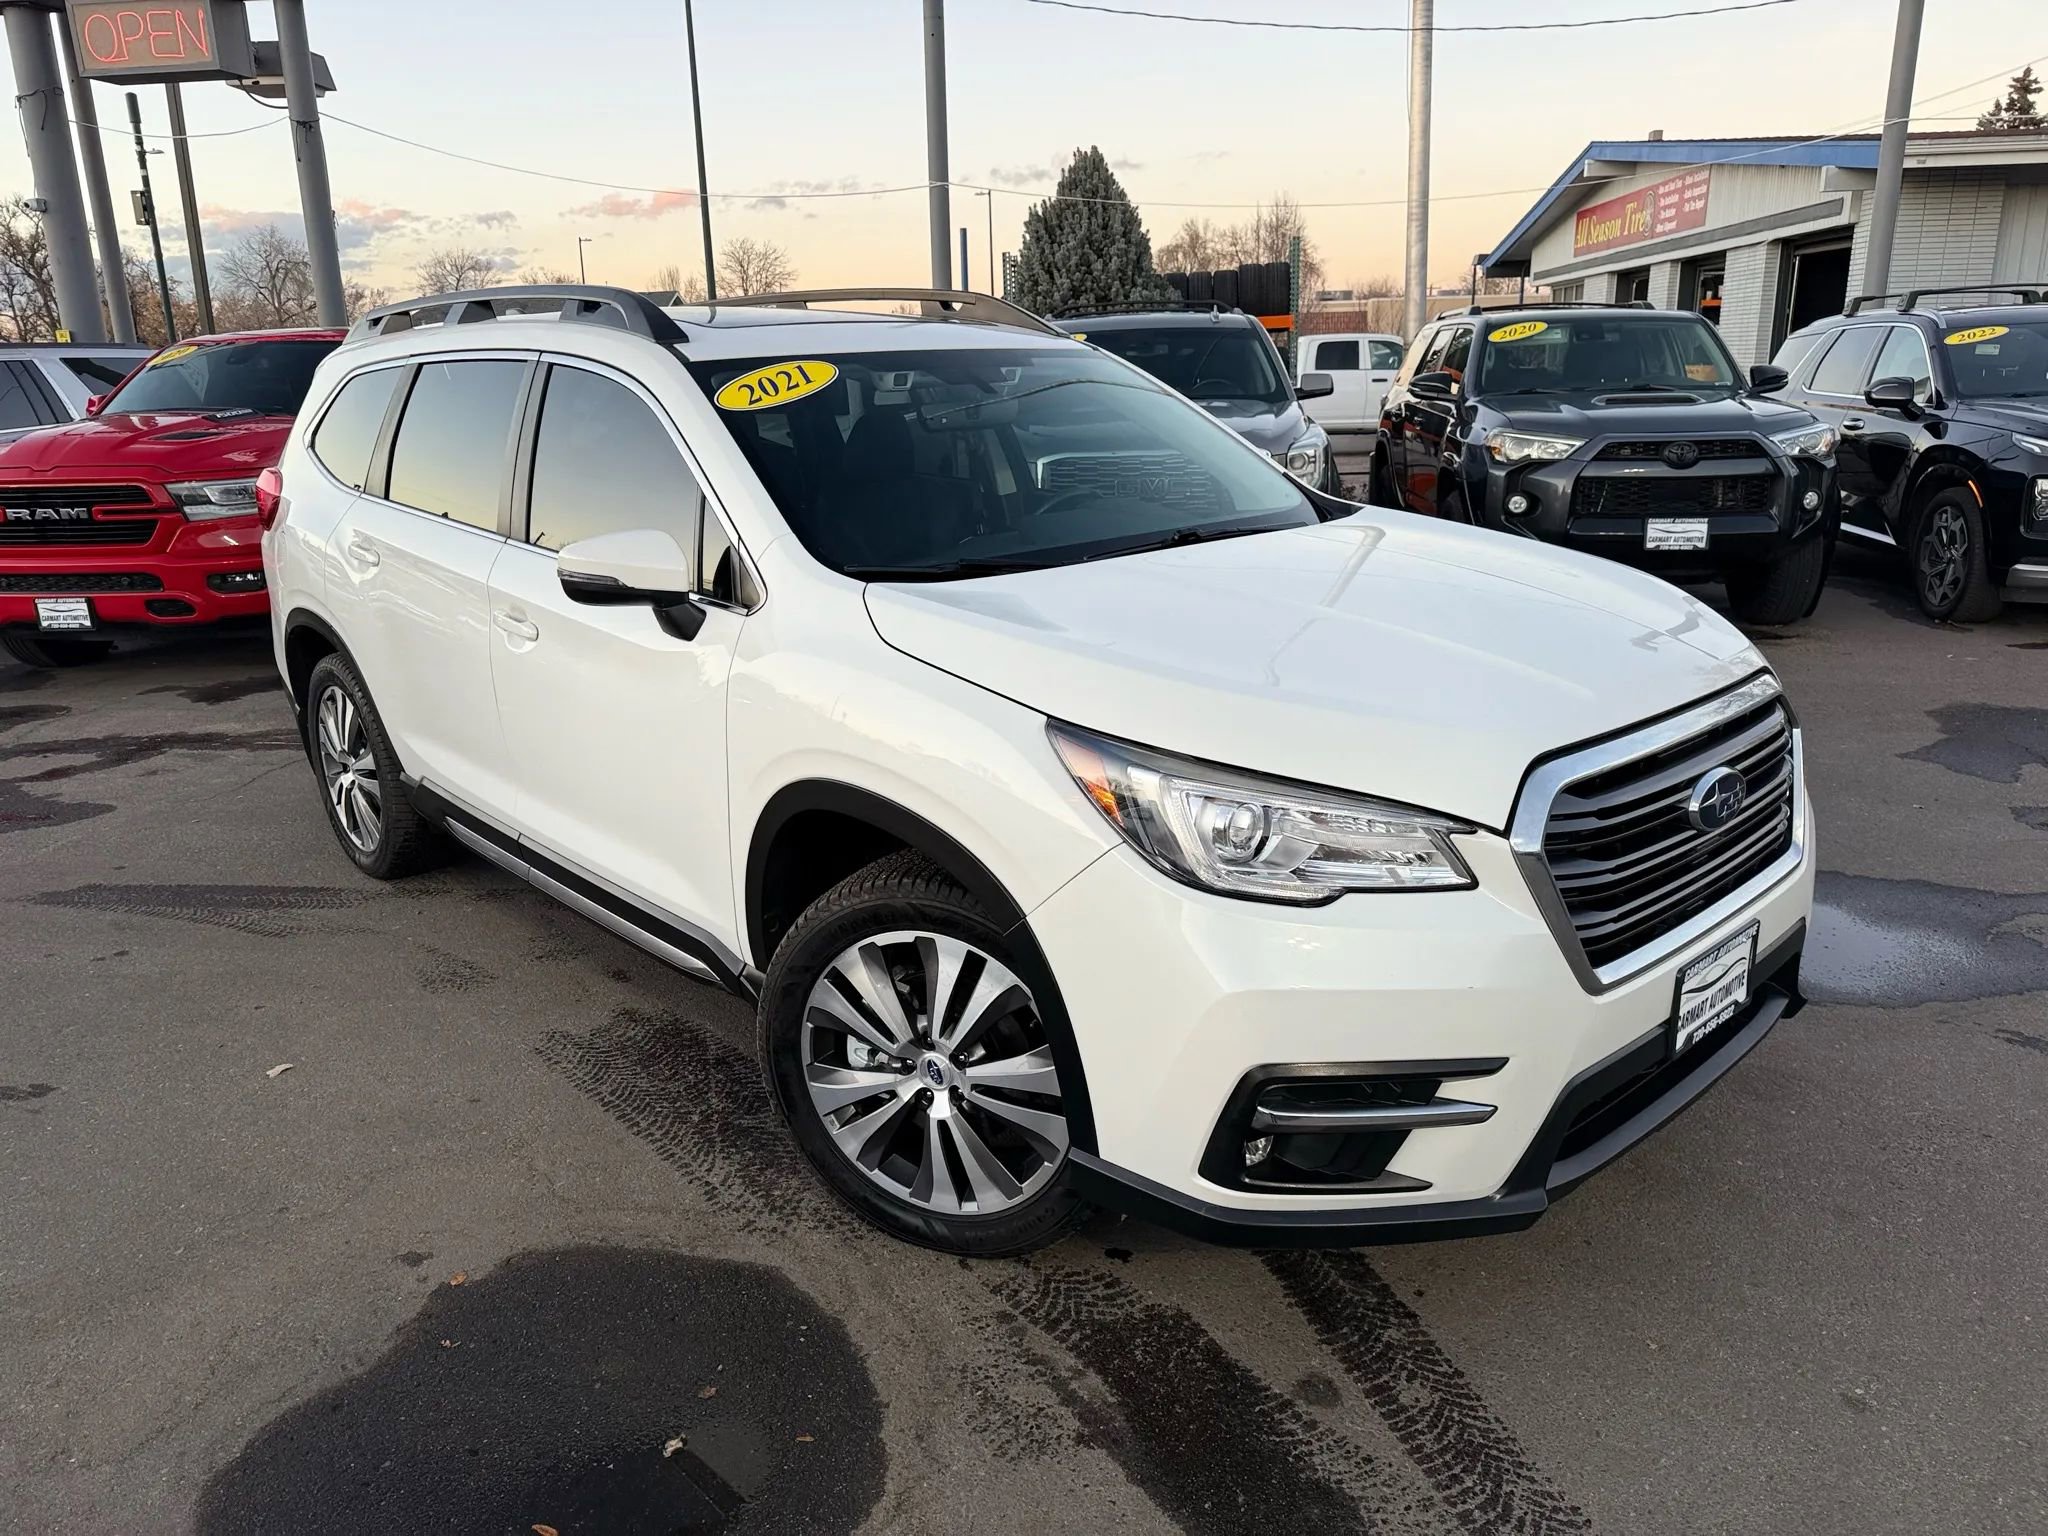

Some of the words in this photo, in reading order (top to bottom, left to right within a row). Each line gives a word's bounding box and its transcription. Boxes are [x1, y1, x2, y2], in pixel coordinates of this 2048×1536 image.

[85, 9, 208, 62] OPEN
[1574, 217, 1589, 248] All
[1588, 215, 1622, 245] Season
[1623, 201, 1646, 236] Tire
[1498, 323, 1537, 340] 2020
[1957, 327, 1997, 342] 2022
[737, 364, 816, 406] 2021
[5, 507, 88, 520] RAM
[1708, 969, 1747, 1013] AUTOMOTIVE
